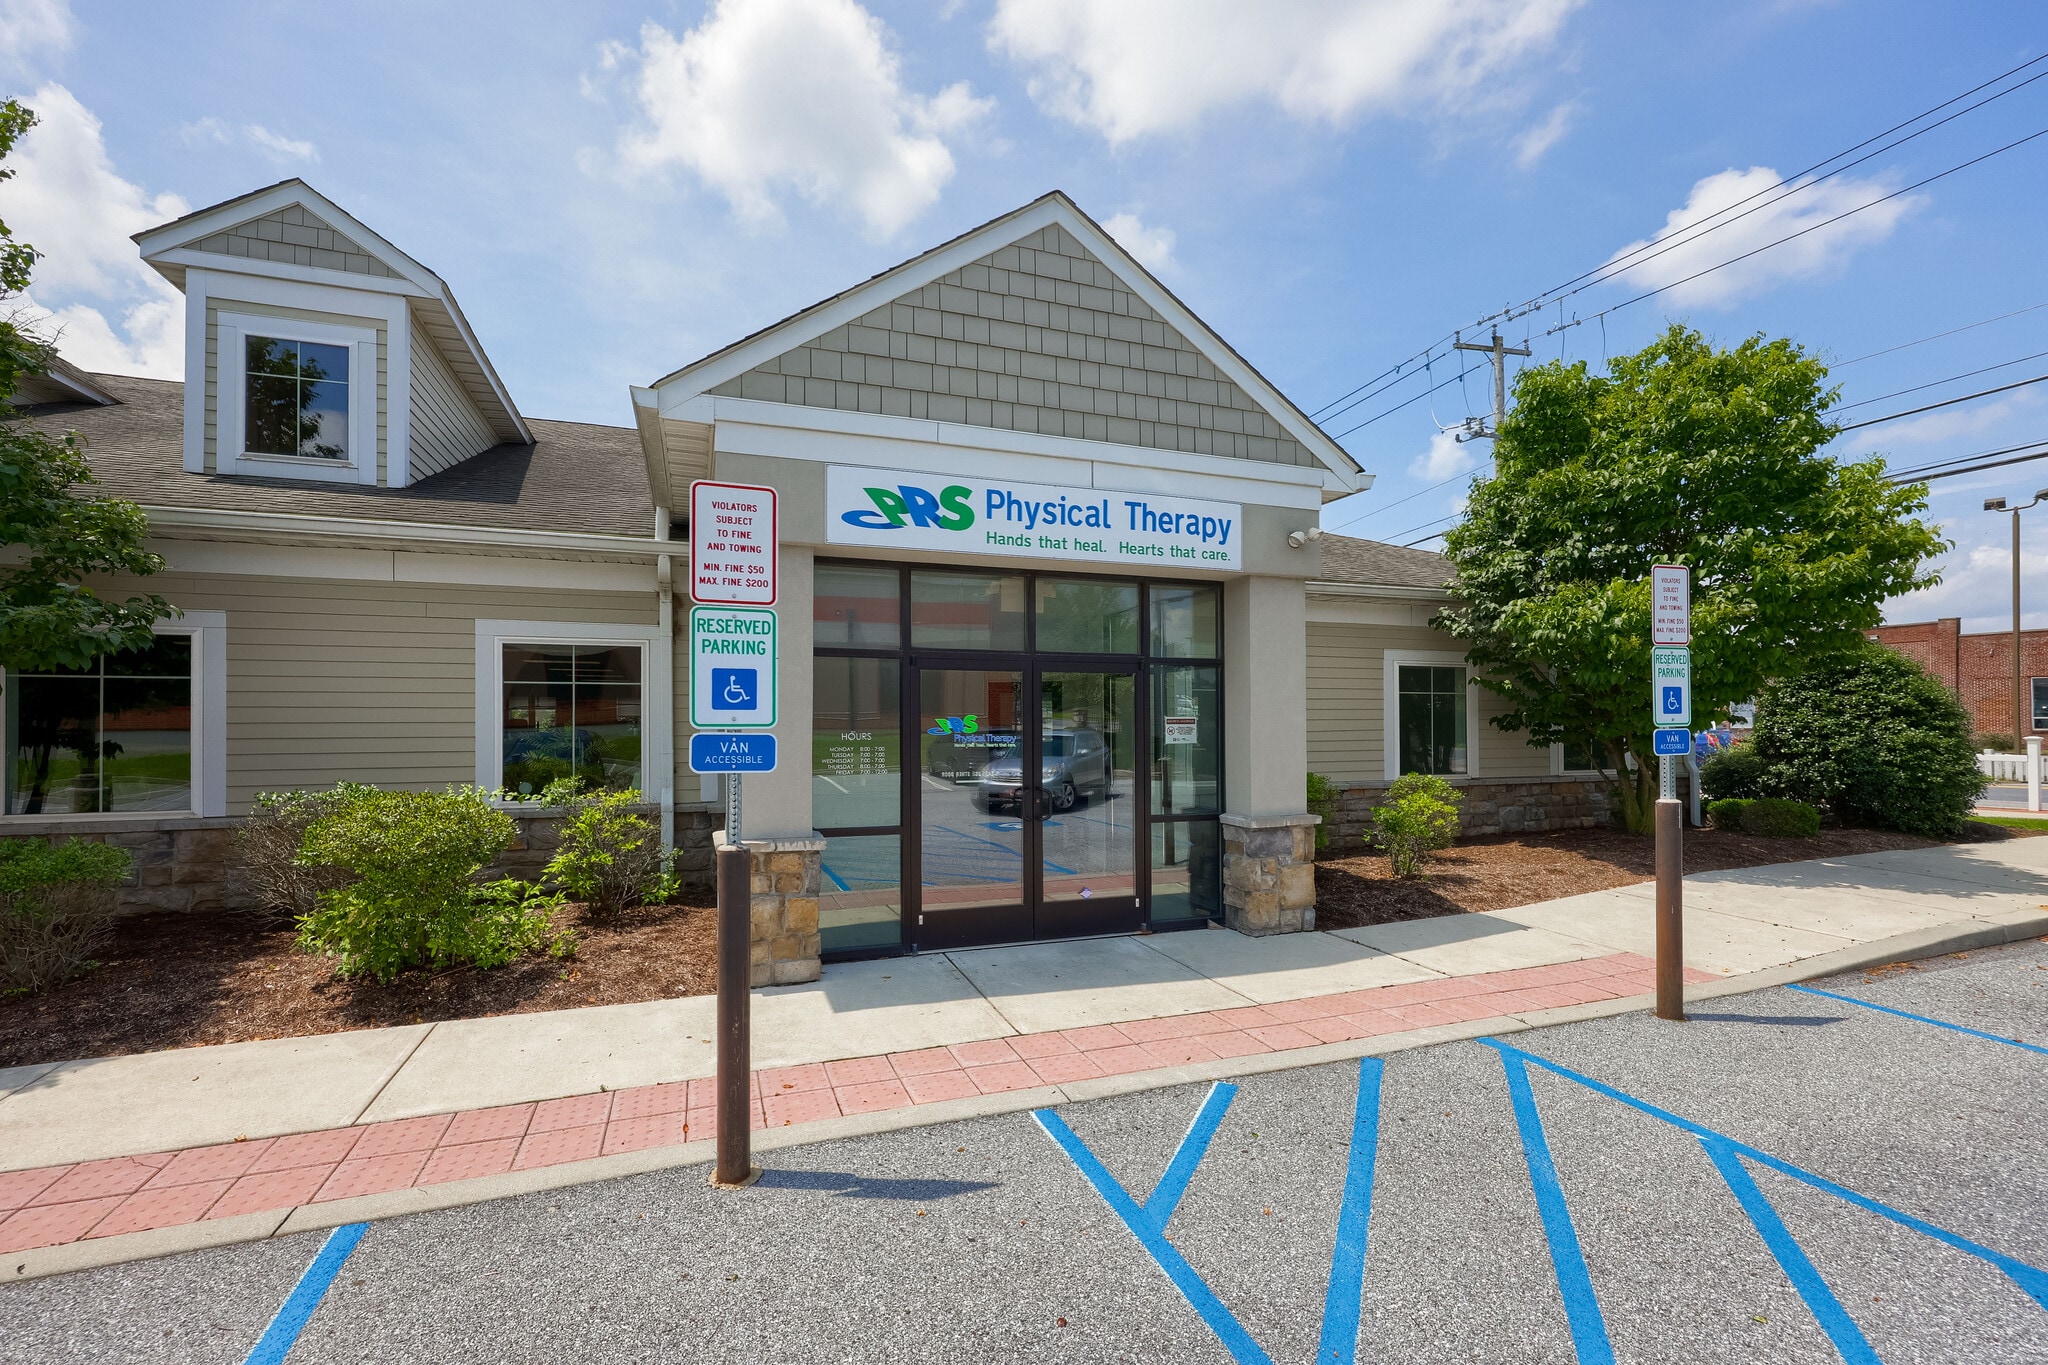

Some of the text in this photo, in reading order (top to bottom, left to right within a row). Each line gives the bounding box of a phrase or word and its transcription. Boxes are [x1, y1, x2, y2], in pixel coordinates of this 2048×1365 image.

[712, 501, 757, 512] VIOLATORS
[716, 516, 752, 525] SUBJECT
[986, 489, 1111, 530] Physical
[1125, 501, 1231, 545] Therapy
[717, 529, 752, 539] TO FINE
[707, 543, 761, 553] AND TOWING
[986, 531, 1230, 561] Hands that heal. Hearts that care.
[704, 563, 764, 574] MIN. FINE $50
[699, 577, 768, 588] MAX. FINE $200
[697, 618, 771, 635] RESERVED
[702, 639, 766, 655] PARKING
[1656, 654, 1687, 665] RESERVED
[1658, 668, 1685, 678] PARKING
[841, 732, 872, 740] HOURS
[954, 734, 1016, 743] Physical Therapy
[720, 742, 749, 753] VAN
[705, 755, 763, 764] ACCESSIBLE
